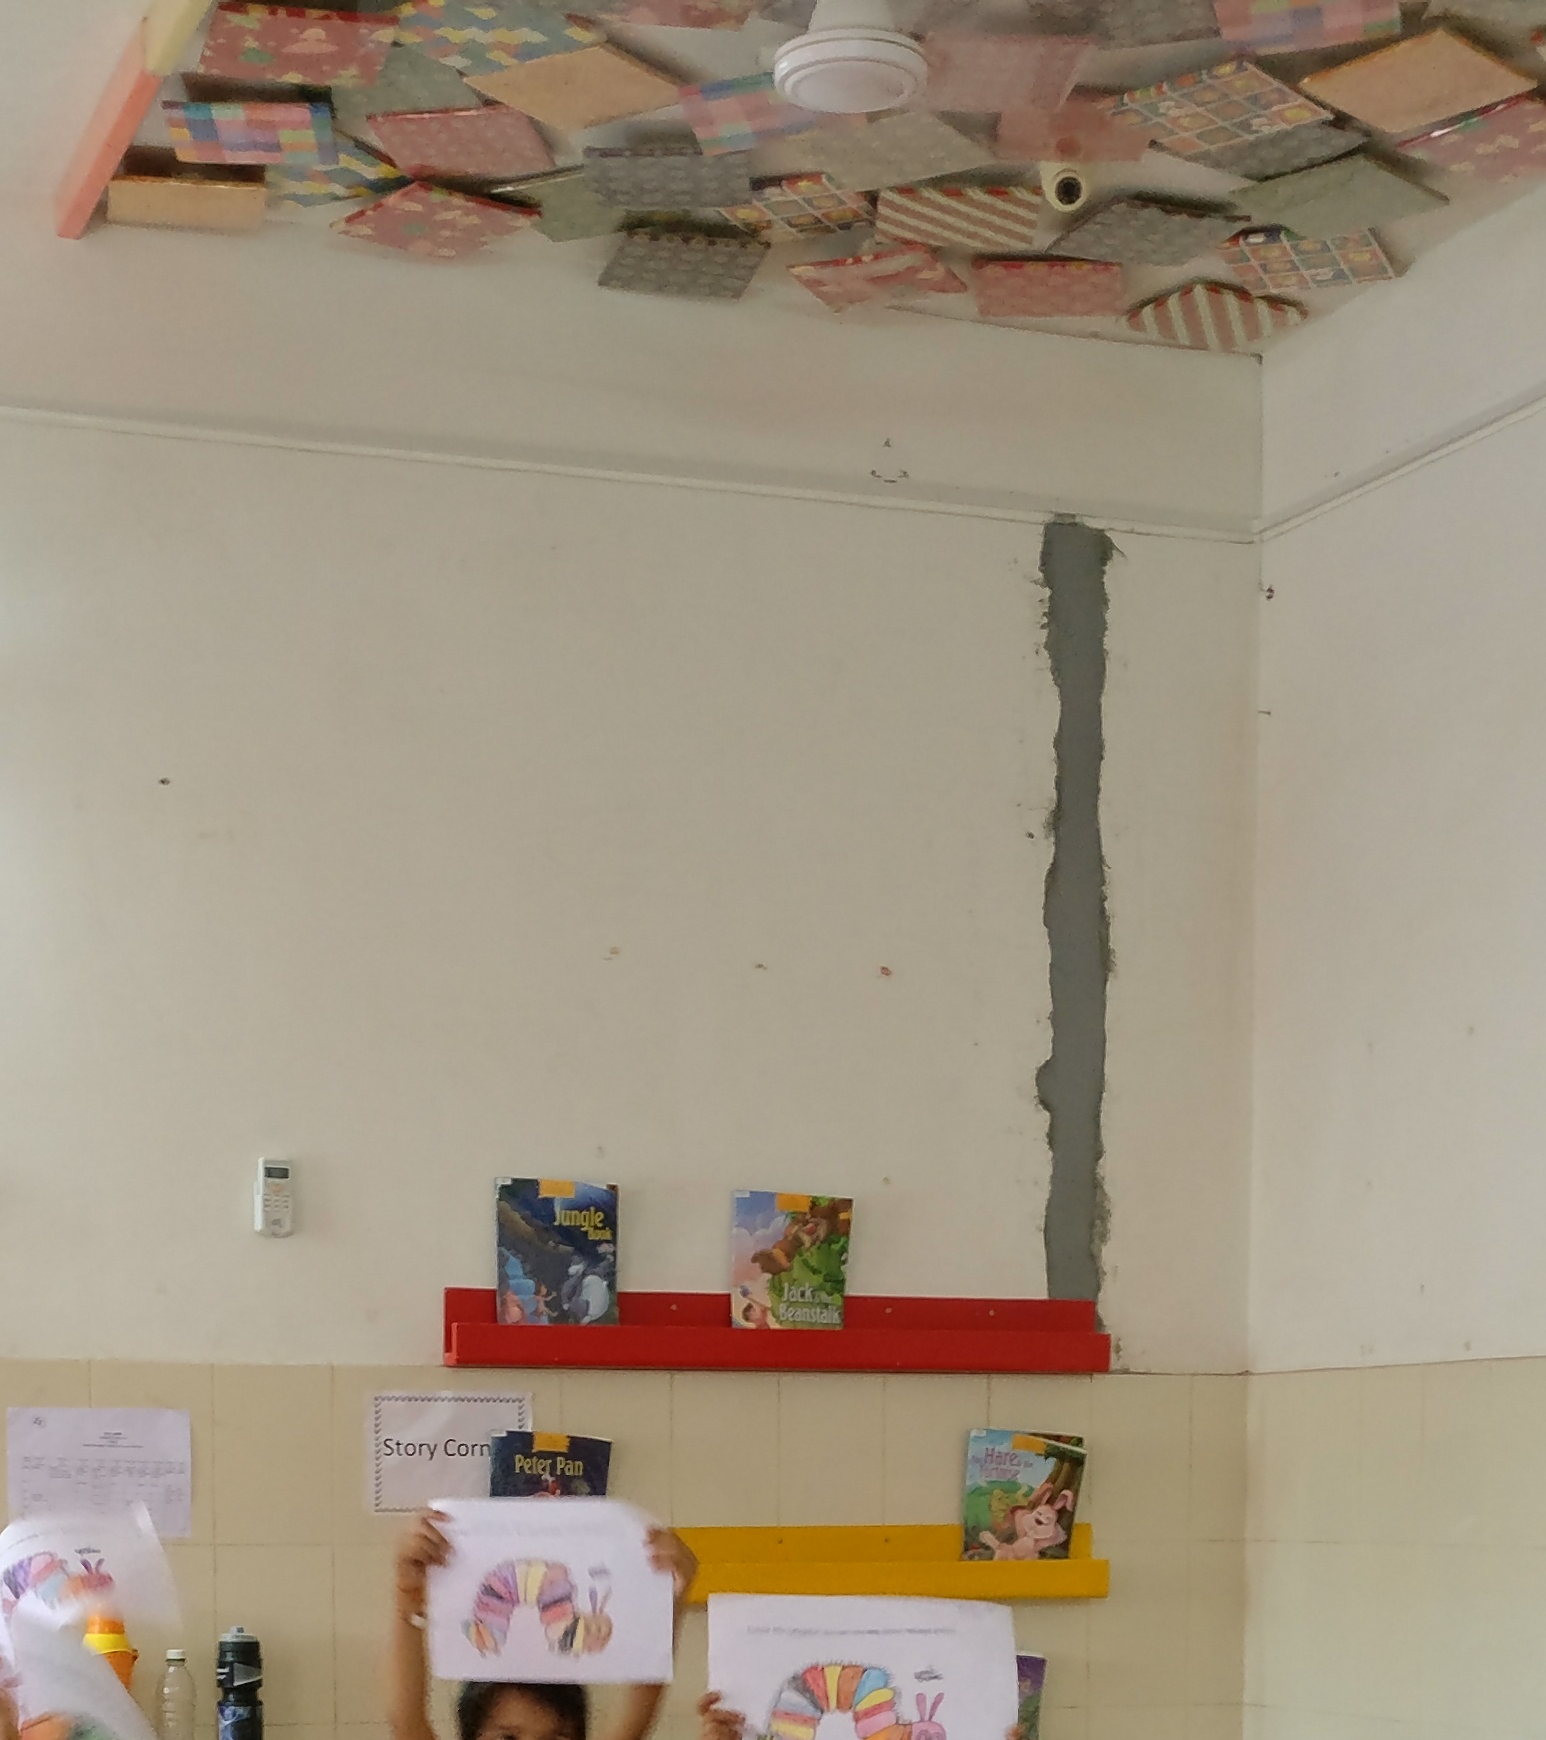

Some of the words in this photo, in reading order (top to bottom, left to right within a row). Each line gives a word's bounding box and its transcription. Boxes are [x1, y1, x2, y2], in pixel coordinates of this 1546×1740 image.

[553, 1206, 605, 1231] Jungle
[782, 1282, 814, 1302] Jack
[778, 1302, 841, 1324] Beanstalk
[383, 1438, 438, 1461] Story
[983, 1447, 1022, 1467] Hare
[514, 1455, 552, 1476] Peter
[556, 1456, 584, 1477] Pan
